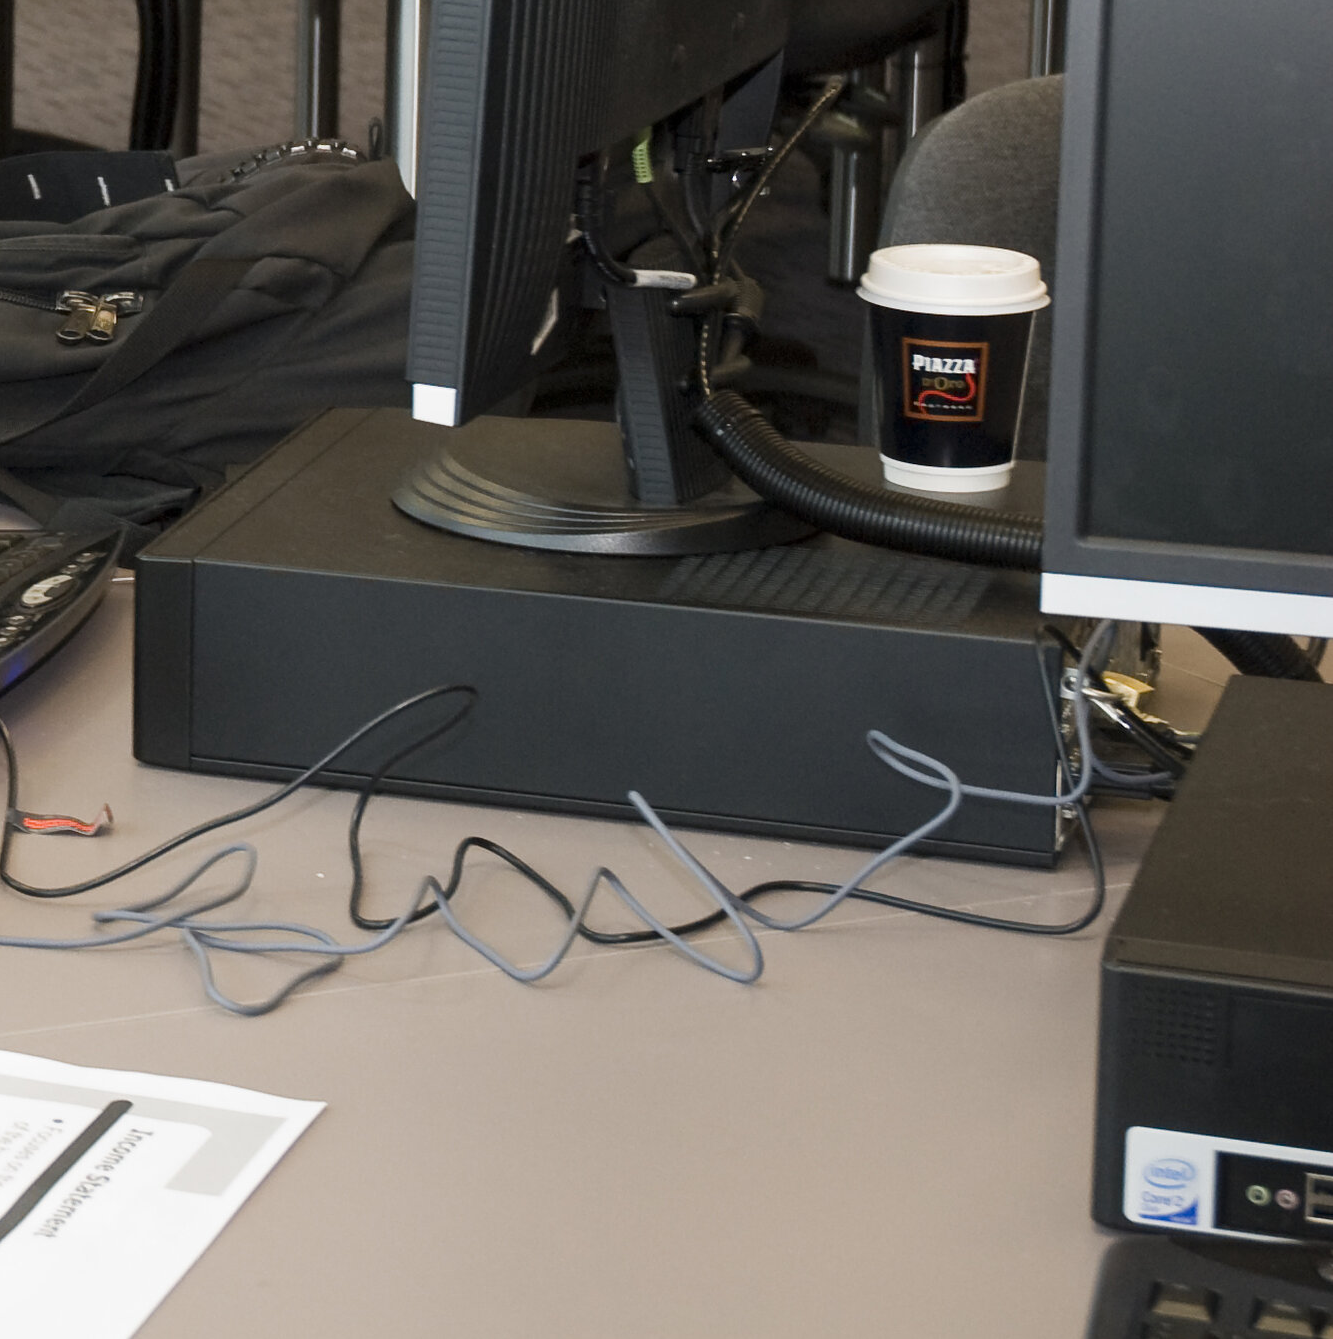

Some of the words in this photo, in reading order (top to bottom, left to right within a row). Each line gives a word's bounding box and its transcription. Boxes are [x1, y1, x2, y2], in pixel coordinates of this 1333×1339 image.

[912, 354, 976, 374] PIAZZA
[94, 1127, 154, 1173] Income
[33, 1173, 111, 1239] Statement
